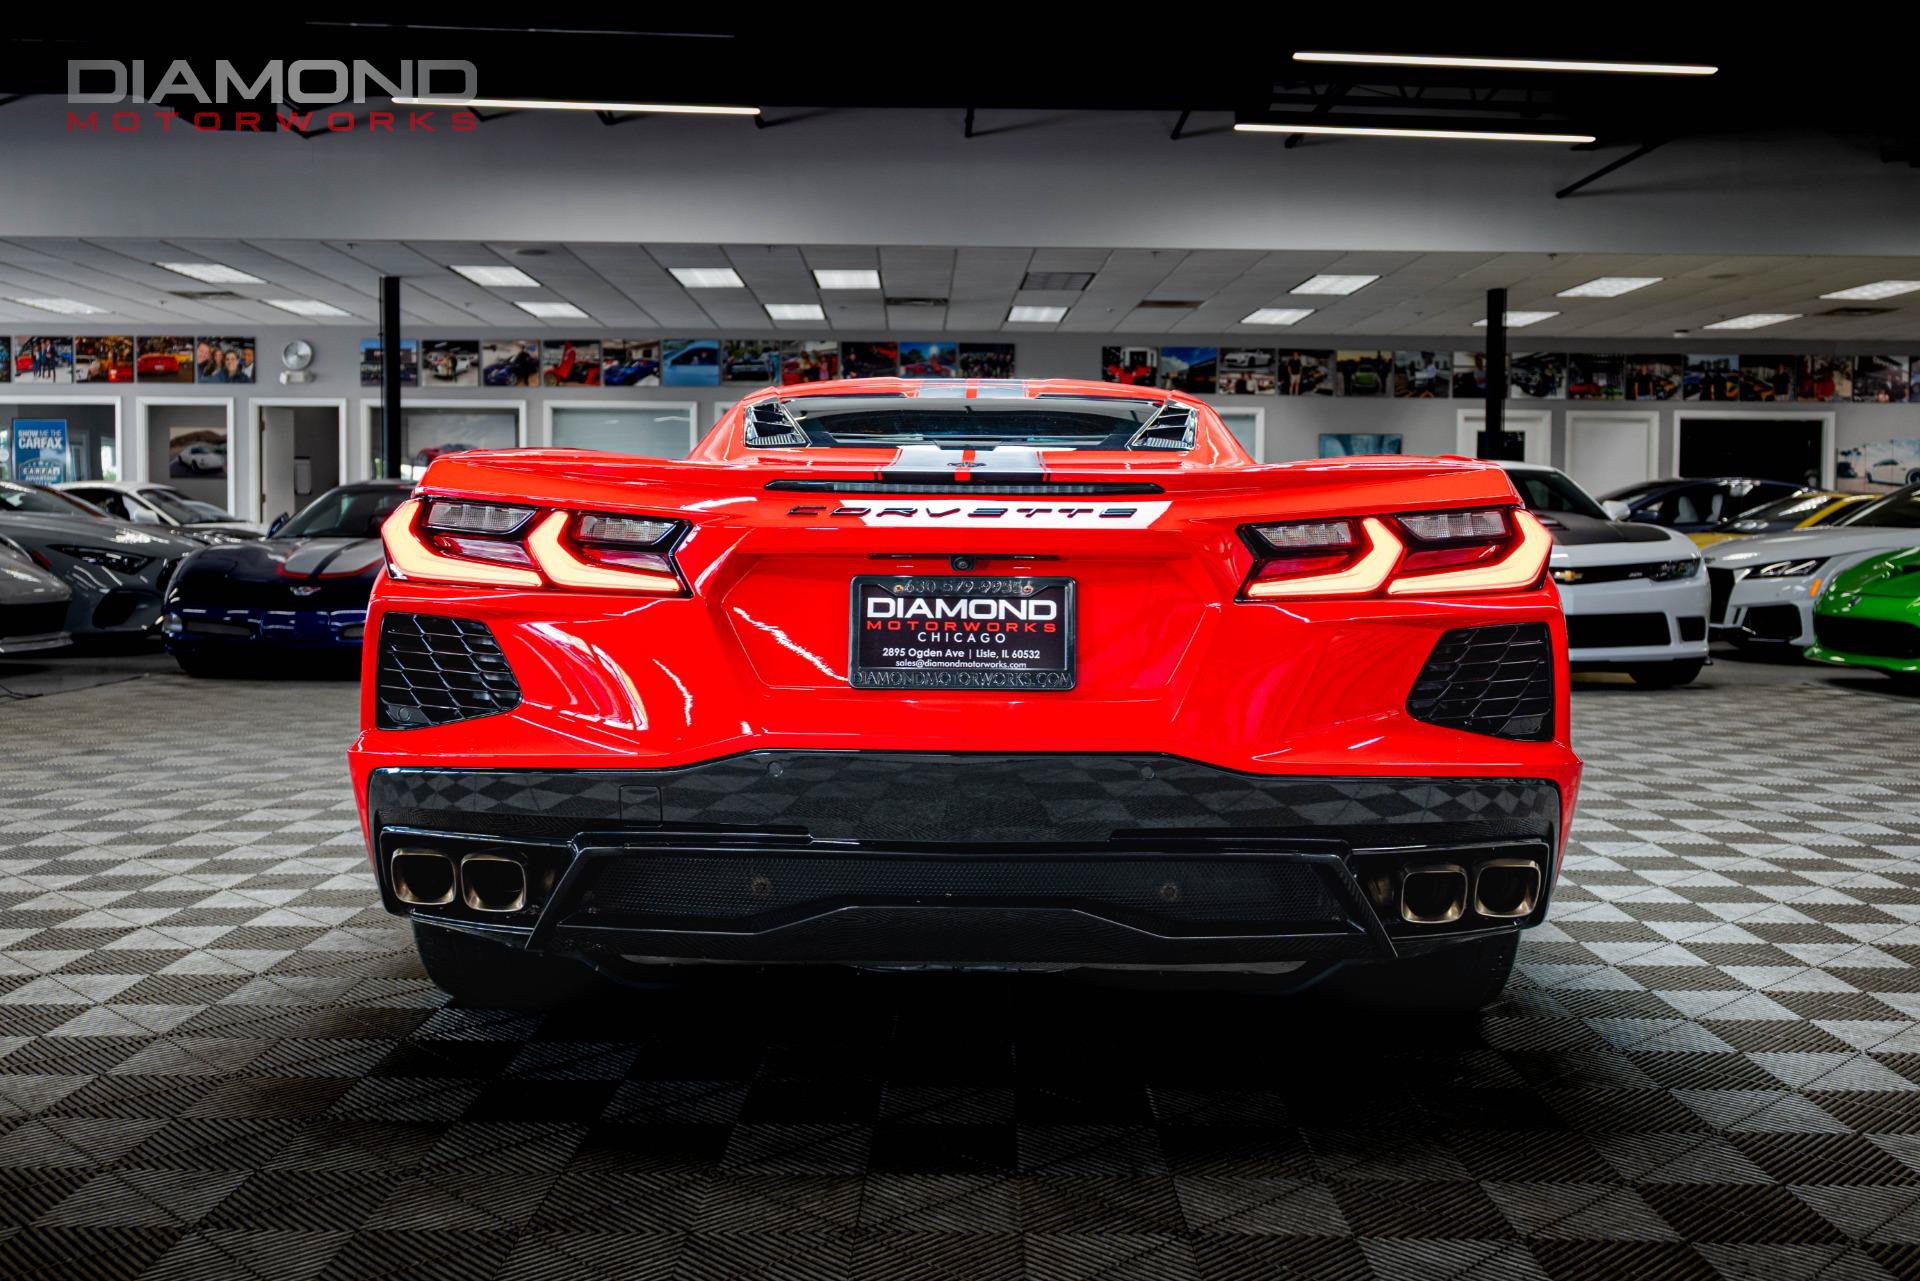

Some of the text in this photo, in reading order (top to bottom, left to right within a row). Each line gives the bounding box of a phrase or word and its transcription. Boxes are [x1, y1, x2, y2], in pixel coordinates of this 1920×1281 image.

[18, 437, 63, 449] CARFAX
[786, 506, 1138, 519] CORVETTE
[867, 597, 1057, 620] DIAMOND
[867, 620, 1057, 633] MOTORWORKS
[917, 632, 1006, 643] CHICAGO
[882, 648, 906, 657] 2895
[908, 648, 943, 658] Ogden
[945, 648, 965, 657] Ave
[976, 649, 999, 659] Lisle,
[1001, 650, 1010, 659] IL
[1011, 650, 1041, 659] 60532
[895, 659, 1027, 669] sales@diamondmotorworks.com
